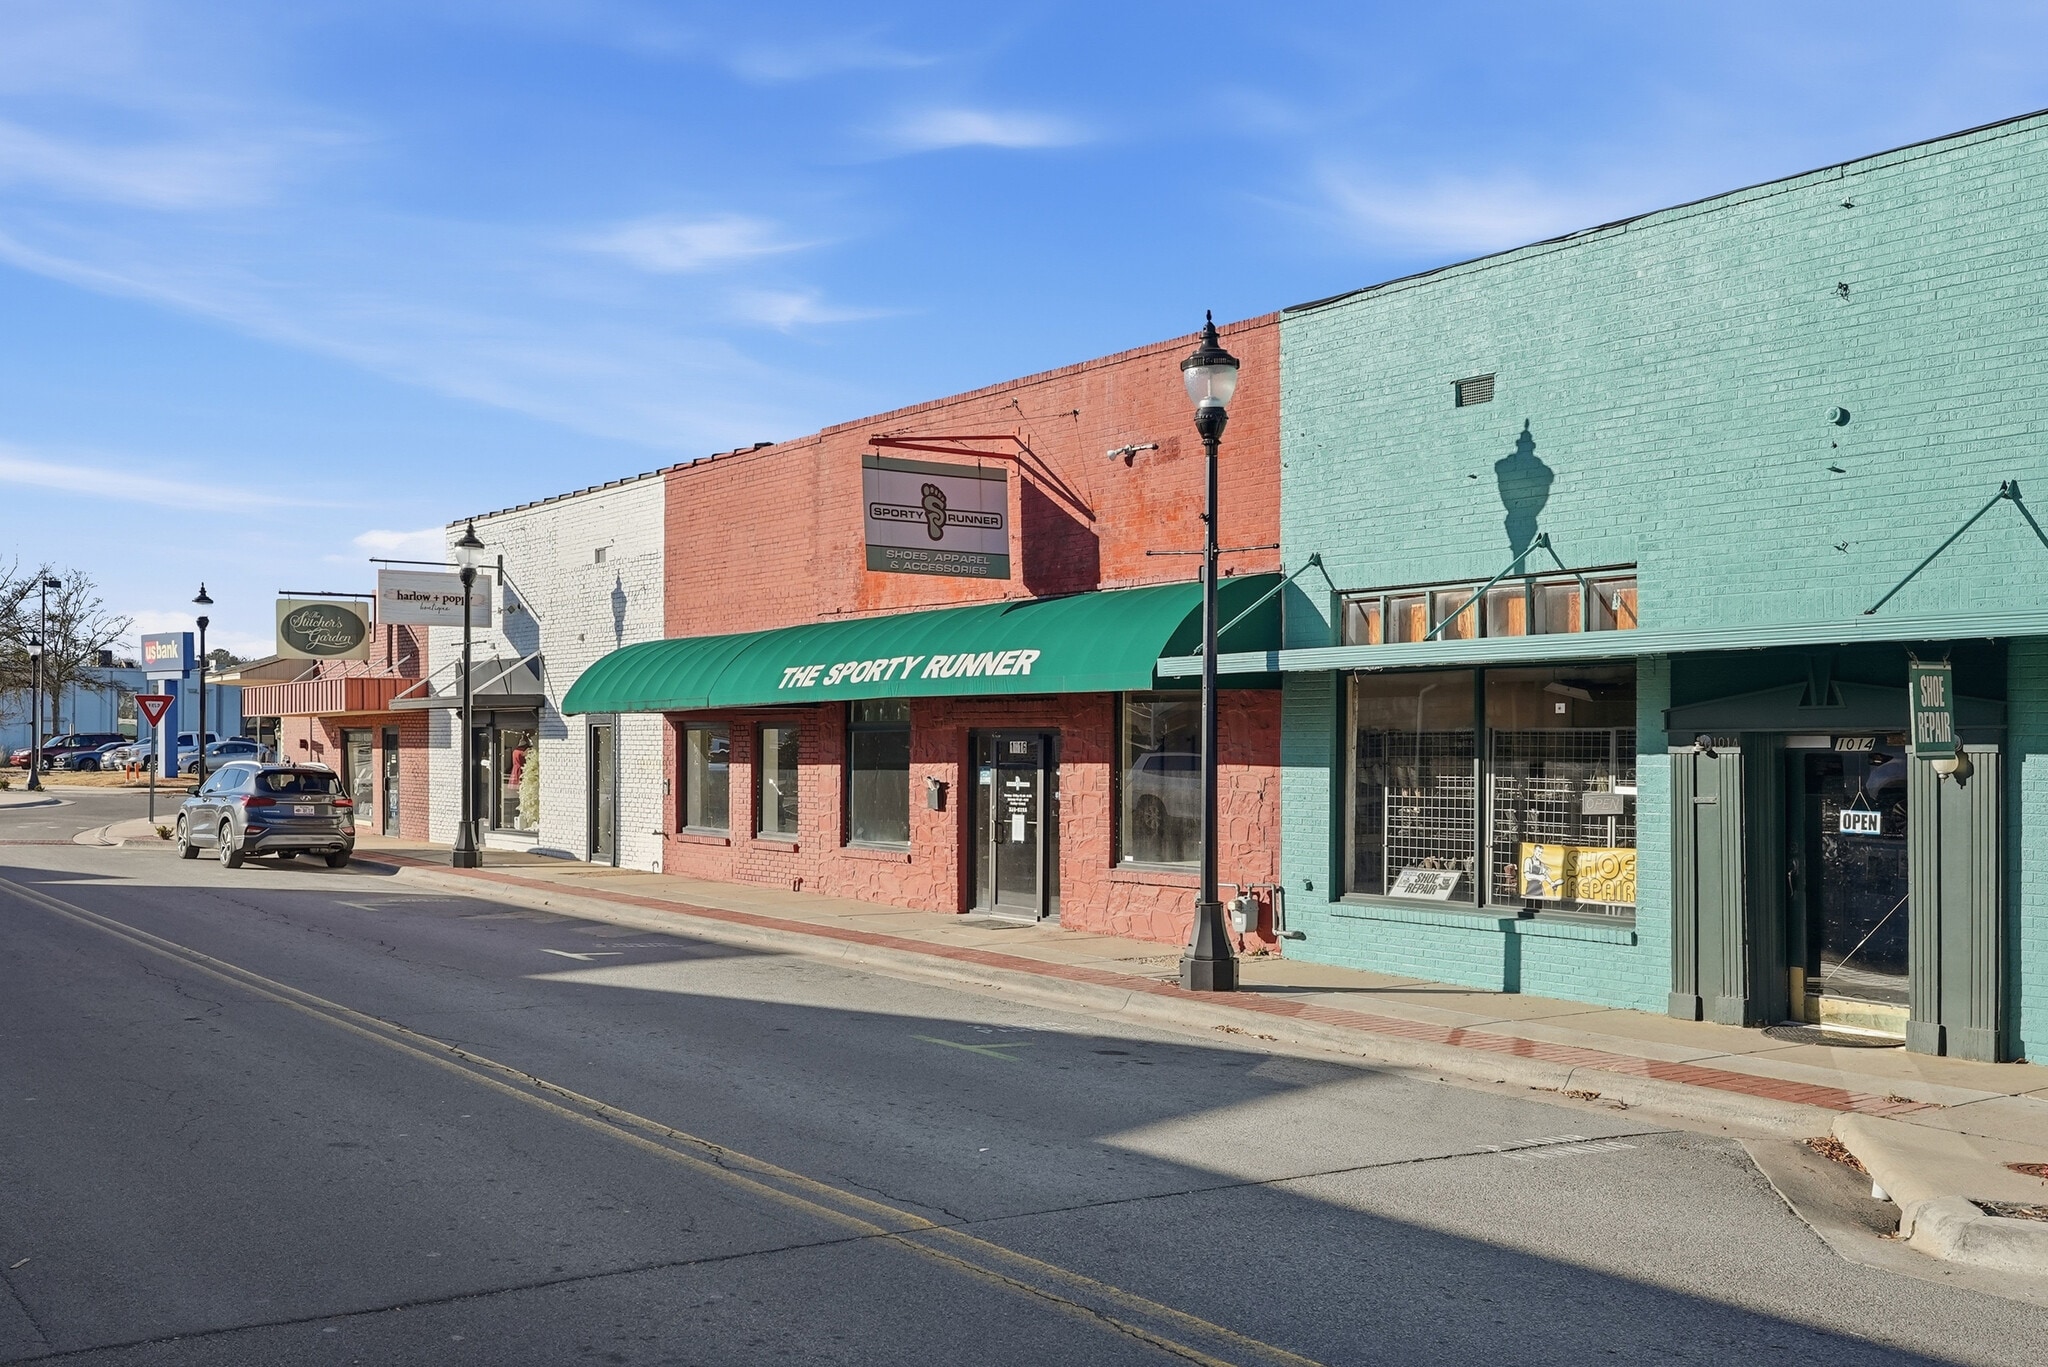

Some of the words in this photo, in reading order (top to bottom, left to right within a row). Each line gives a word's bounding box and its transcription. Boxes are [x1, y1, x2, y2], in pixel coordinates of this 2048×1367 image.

[873, 507, 923, 519] SPORTY
[947, 513, 999, 526] RUNNER
[886, 549, 930, 562] SHOES,
[934, 553, 990, 565] APPAREL
[890, 560, 899, 569] &
[902, 561, 987, 575] ACCESSORIES
[397, 590, 431, 602] harlow
[443, 595, 473, 606] pop
[290, 611, 343, 630] Stitcher's
[306, 627, 354, 650] Garden
[778, 664, 825, 689] THE
[822, 655, 925, 687] SPORTY
[920, 649, 1040, 680] RUNNER
[1920, 675, 1945, 707] SHOE
[1917, 711, 1951, 743] REPAIR
[1838, 738, 1874, 750] 1014
[1586, 798, 1619, 811] OPEN
[1843, 813, 1878, 831] OPEN
[1566, 850, 1637, 880] SHOE
[1415, 872, 1441, 885] SHOE
[1404, 882, 1438, 895] REPAIR
[1566, 876, 1637, 903] REPAIR
